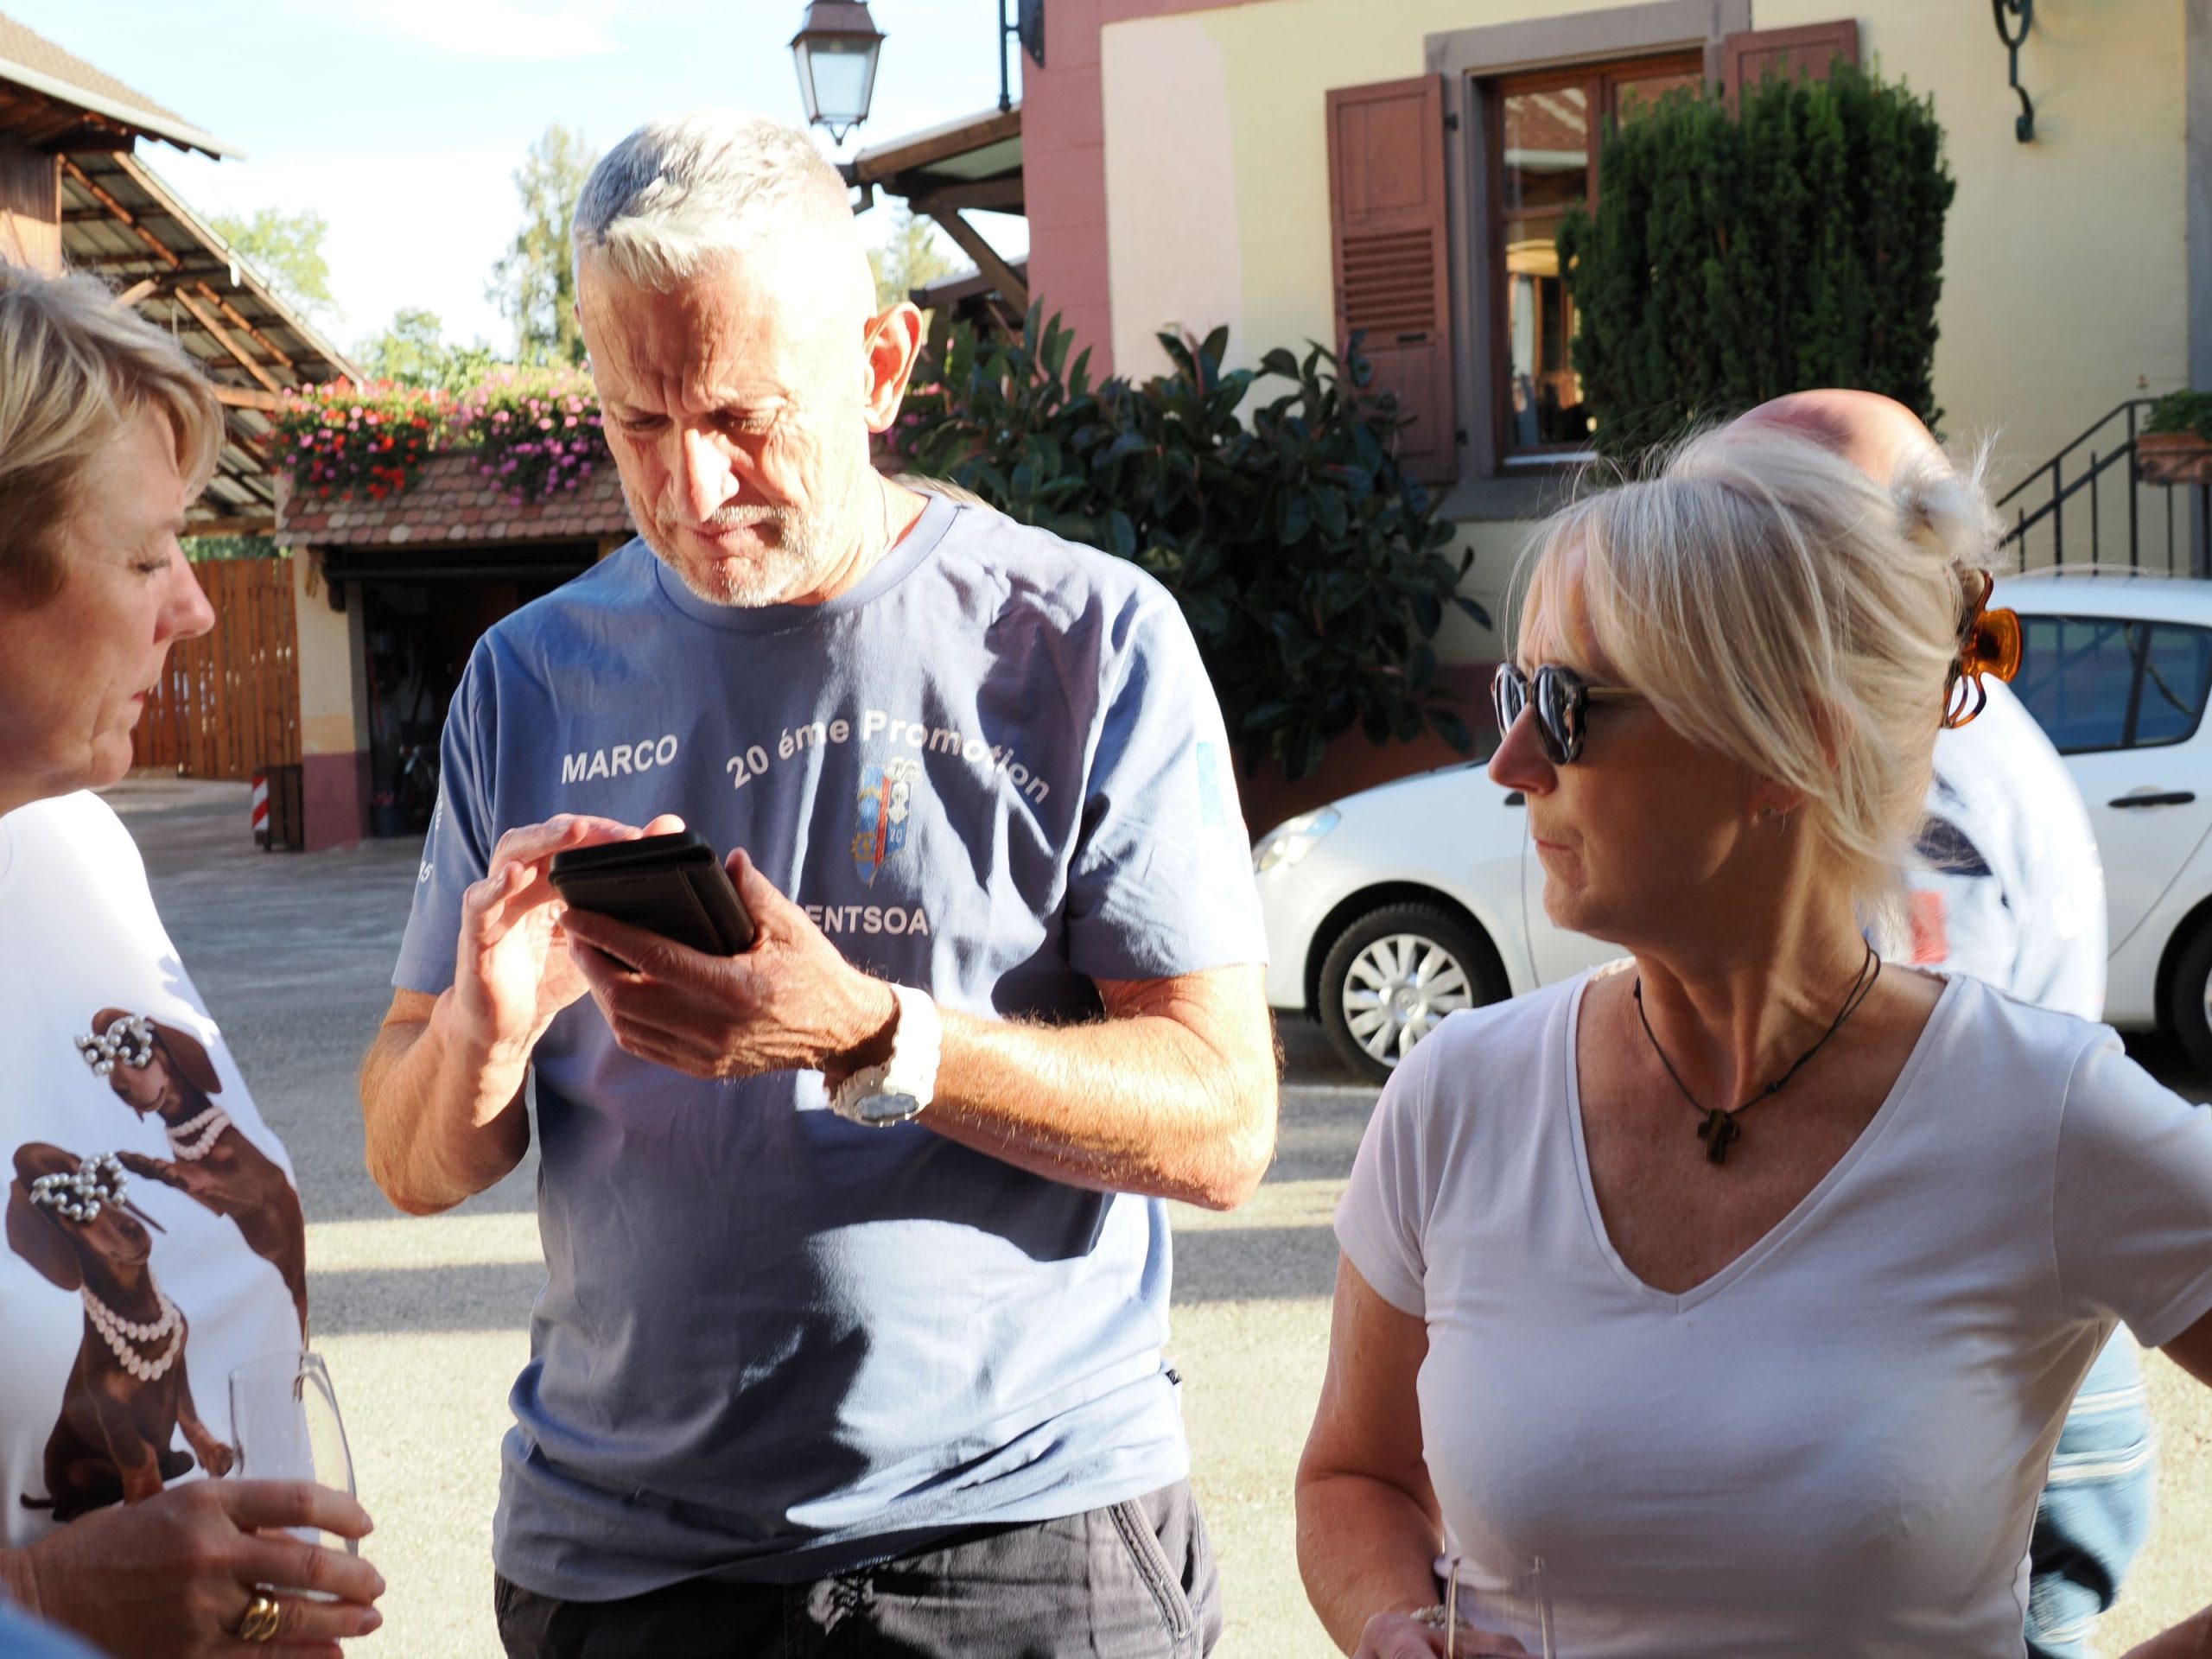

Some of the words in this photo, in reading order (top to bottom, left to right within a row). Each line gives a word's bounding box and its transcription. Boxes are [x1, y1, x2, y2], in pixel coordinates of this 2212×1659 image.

[562, 734, 677, 785] MARCO
[726, 745, 769, 790] 20
[778, 719, 850, 760] éme
[862, 709, 1050, 804] Promotion
[889, 828, 903, 842] 20
